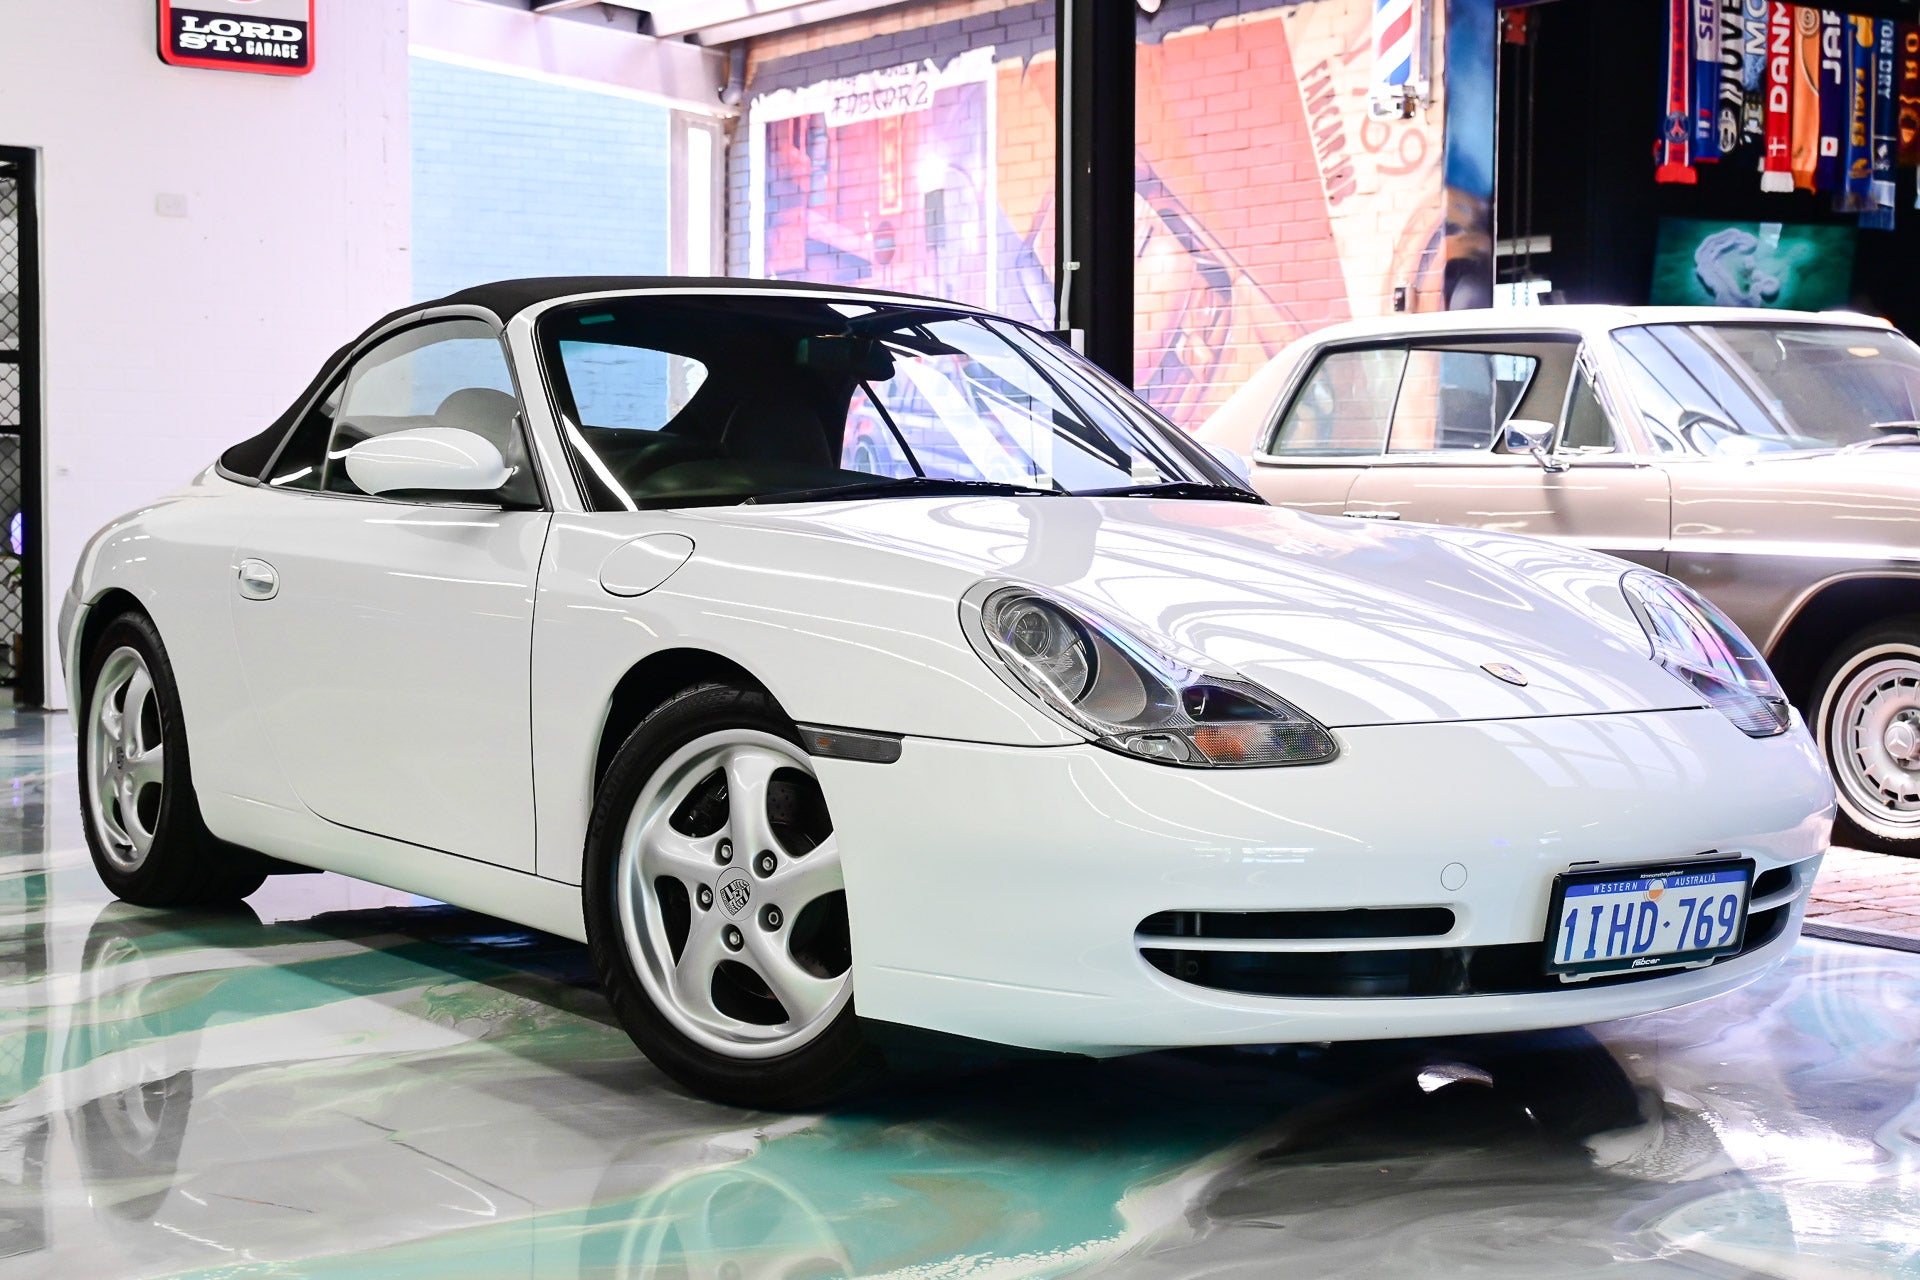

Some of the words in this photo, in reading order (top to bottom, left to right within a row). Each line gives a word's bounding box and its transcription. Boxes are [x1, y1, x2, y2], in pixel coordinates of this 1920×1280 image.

[181, 15, 303, 42] LORD
[179, 32, 242, 53] ST.
[246, 40, 299, 59] GARAGE
[1851, 67, 1867, 147] EAGLES
[1593, 882, 1638, 893] WESTERN
[1674, 873, 1716, 887] AUSTRALIA
